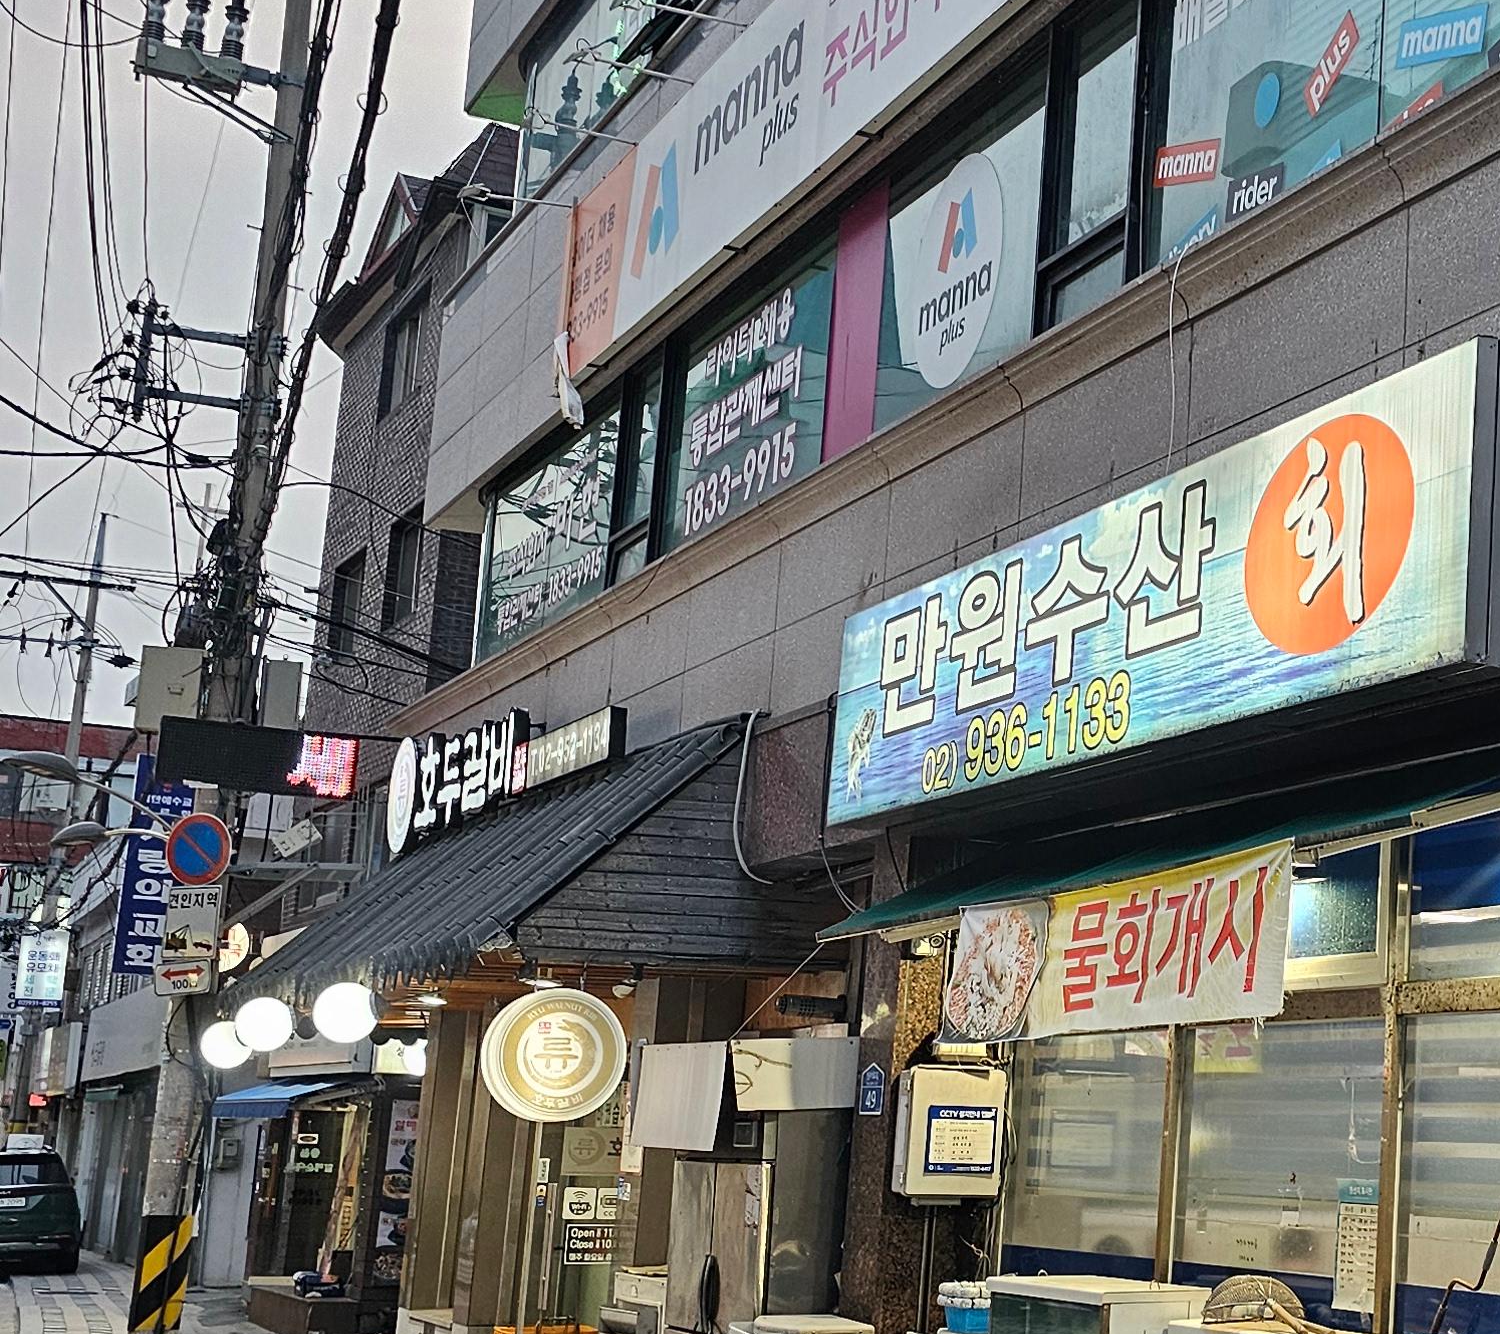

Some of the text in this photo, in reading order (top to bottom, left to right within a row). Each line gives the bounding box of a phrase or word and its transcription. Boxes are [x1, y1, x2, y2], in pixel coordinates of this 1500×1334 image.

[1308, 25, 1351, 115] plus
[1401, 16, 1483, 60] manna
[693, 19, 805, 175] manna
[759, 92, 799, 166] plus
[1157, 147, 1217, 180] manna
[1232, 175, 1278, 215] rider
[918, 260, 993, 336] manna
[939, 317, 965, 355] plus
[704, 287, 795, 387] 라이더 채용
[690, 344, 804, 468] 통합관제센터
[683, 421, 797, 537] 1833-9915
[1283, 437, 1367, 625] 회
[548, 545, 603, 607] 1833-9915
[880, 478, 1216, 739] 만원수산
[964, 669, 1131, 782] 936-1133
[413, 709, 514, 829] 호두갈비
[169, 891, 218, 909] 견인지역
[1062, 866, 1268, 1013] 물회개시
[865, 1090, 877, 1109] 49
[570, 1239, 594, 1248] Close
[571, 1228, 595, 1238] Open
